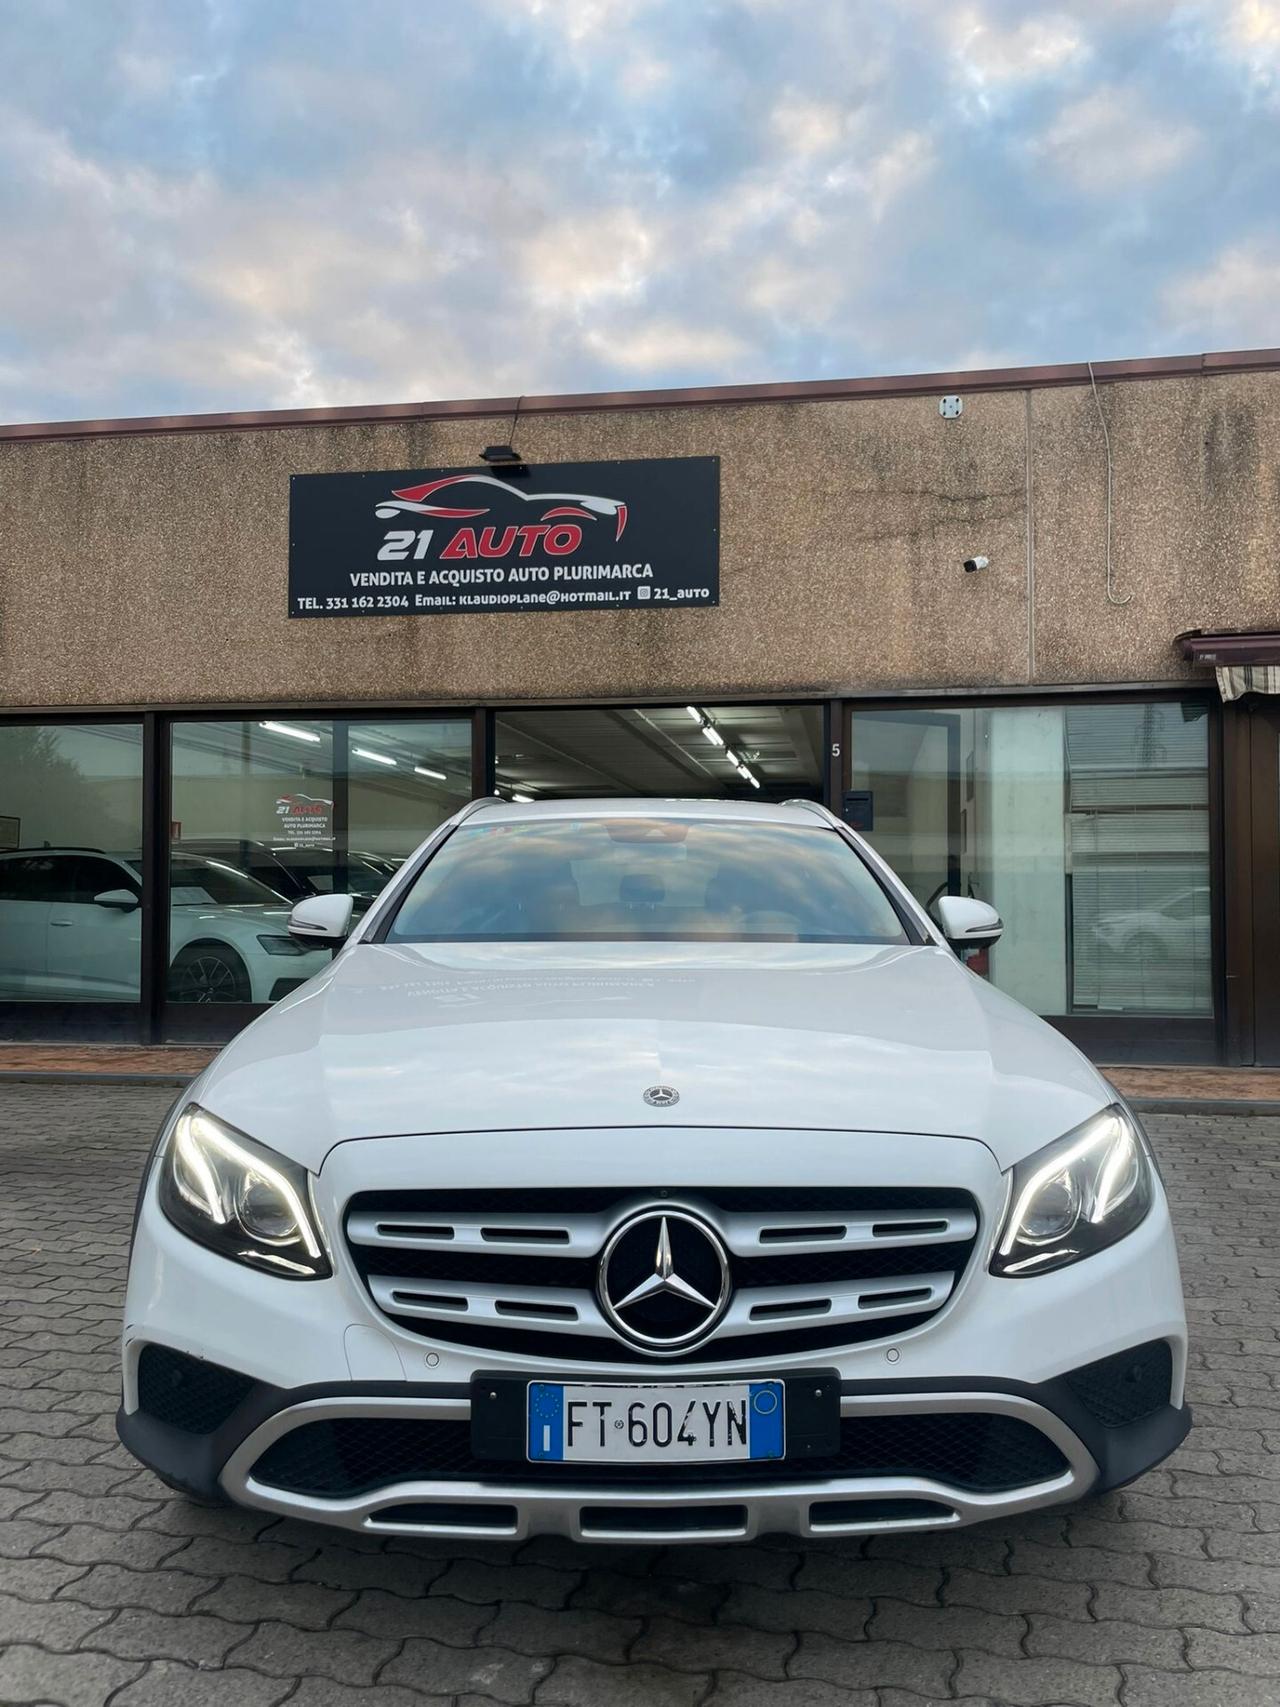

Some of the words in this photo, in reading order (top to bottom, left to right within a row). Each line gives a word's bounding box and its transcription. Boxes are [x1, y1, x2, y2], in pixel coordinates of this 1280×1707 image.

[377, 529, 434, 561] 21
[439, 524, 582, 560] AUTO
[350, 571, 414, 587] VENDITA
[417, 570, 425, 585] E
[429, 568, 505, 587] ACQUISTO
[508, 567, 550, 582] AUTO
[554, 563, 654, 581] PLURIMARCA
[297, 597, 323, 610] TEL.
[325, 597, 349, 610] 331
[351, 596, 374, 608] 162
[377, 595, 409, 609] 2304
[832, 743, 840, 757] 5
[276, 806, 290, 814] 21
[567, 1401, 612, 1447] FT
[628, 1399, 747, 1448] 604YN
